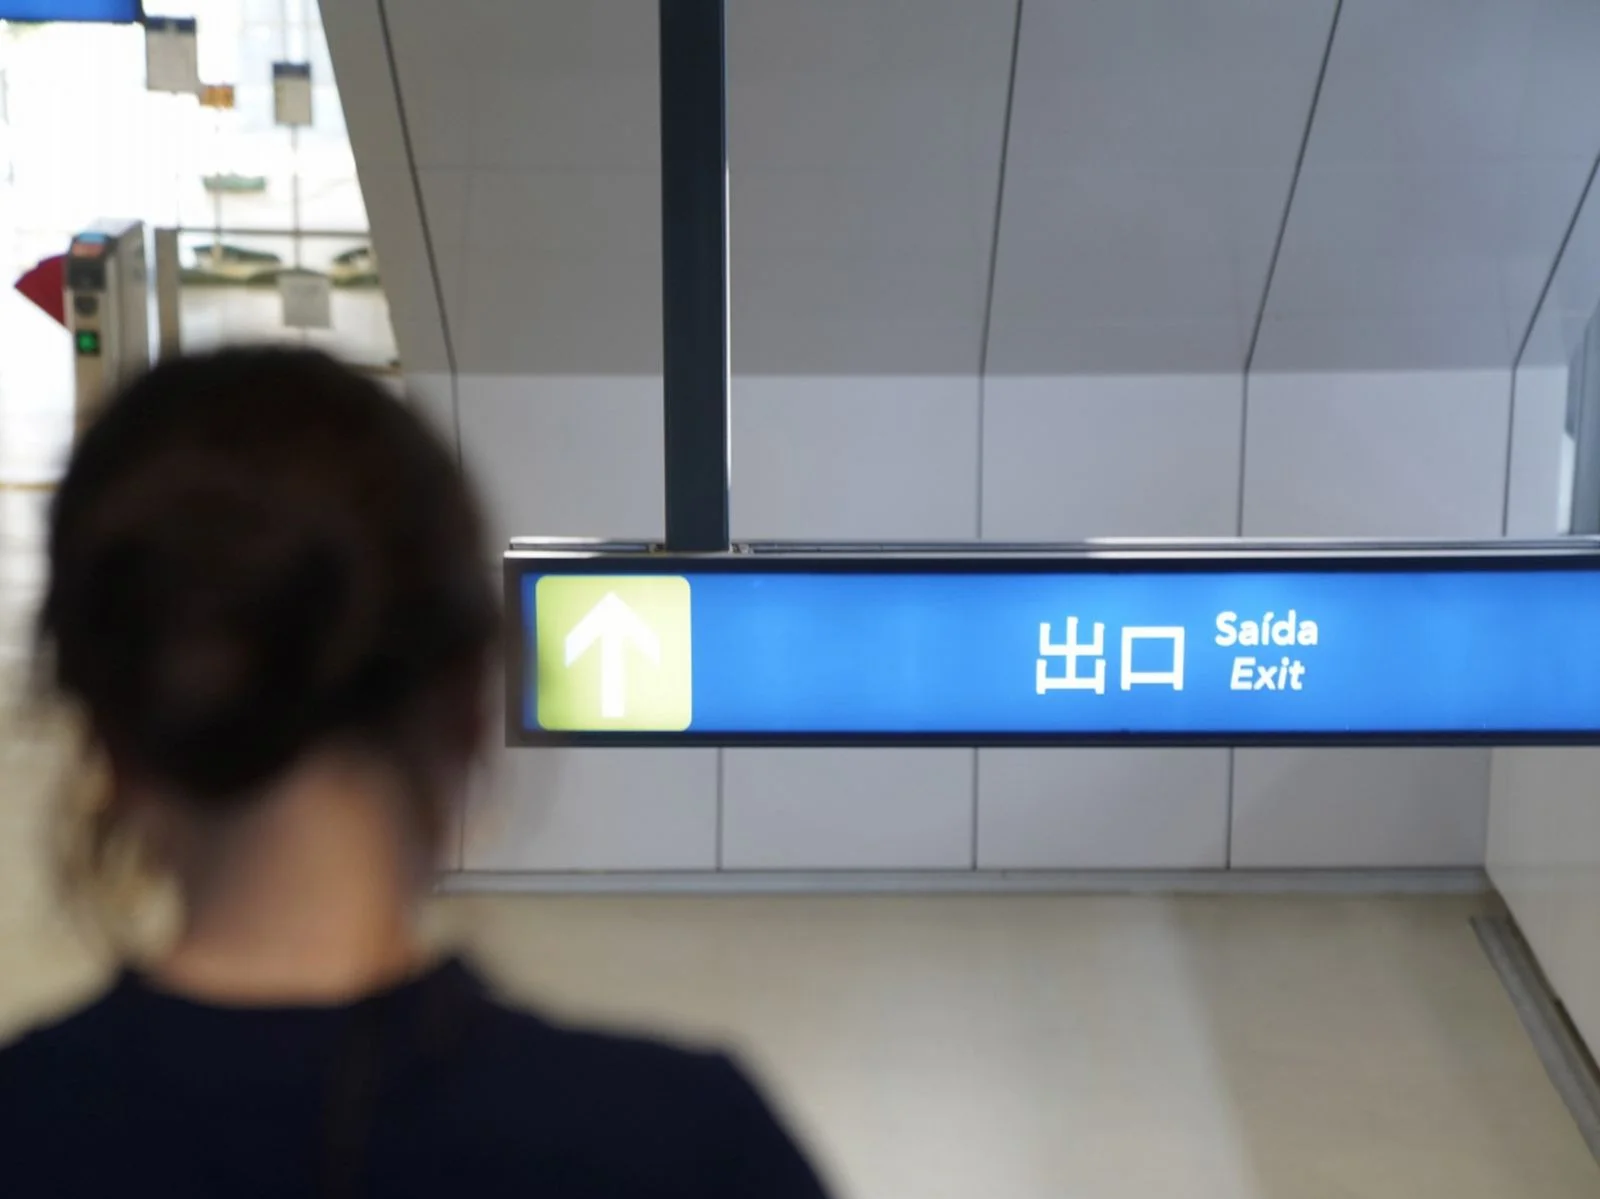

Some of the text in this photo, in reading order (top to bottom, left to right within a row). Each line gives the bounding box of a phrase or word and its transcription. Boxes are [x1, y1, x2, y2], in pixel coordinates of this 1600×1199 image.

[1215, 609, 1319, 646] Saída
[1036, 616, 1186, 694] 出口
[1230, 656, 1306, 690] Exit
